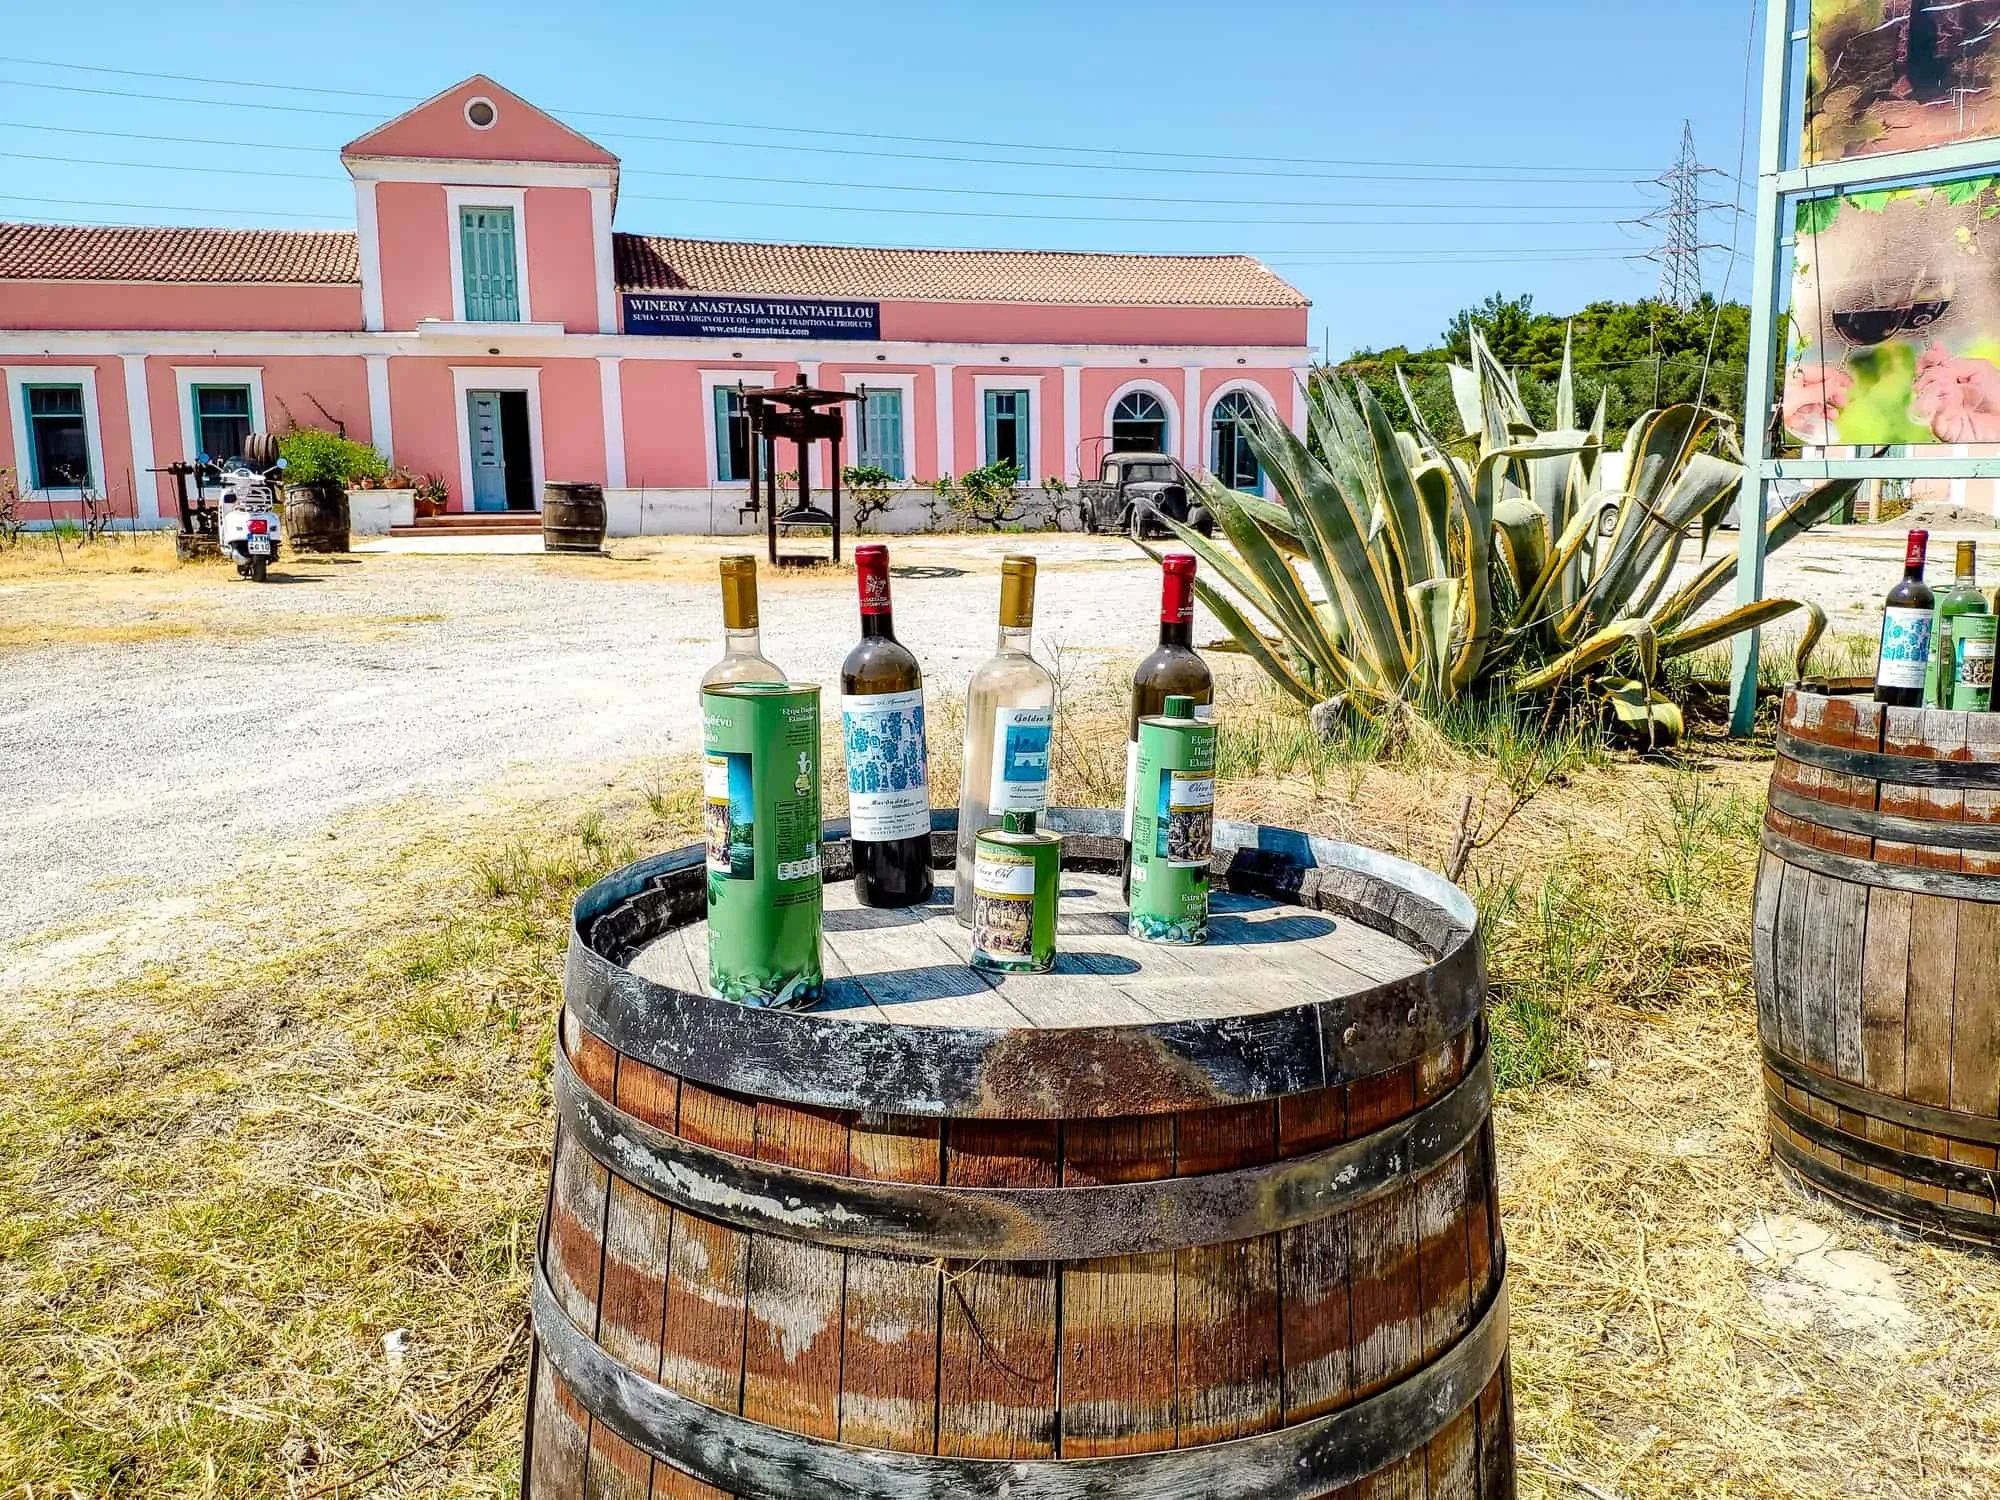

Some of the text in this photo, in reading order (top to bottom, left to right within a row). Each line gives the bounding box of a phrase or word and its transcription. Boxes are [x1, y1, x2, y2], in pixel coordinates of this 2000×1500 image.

[630, 299, 874, 319] WINERY ANASTASIA TRIANTAFILLOU
[632, 313, 654, 321] SUMA
[660, 314, 685, 322] EXTRA
[686, 315, 712, 323] VIRGIN
[713, 316, 737, 324] OLIVE
[789, 319, 835, 327] TRADITIONAL
[836, 320, 873, 328] PRODUCTS
[701, 325, 810, 336] www.estateanastasia.com
